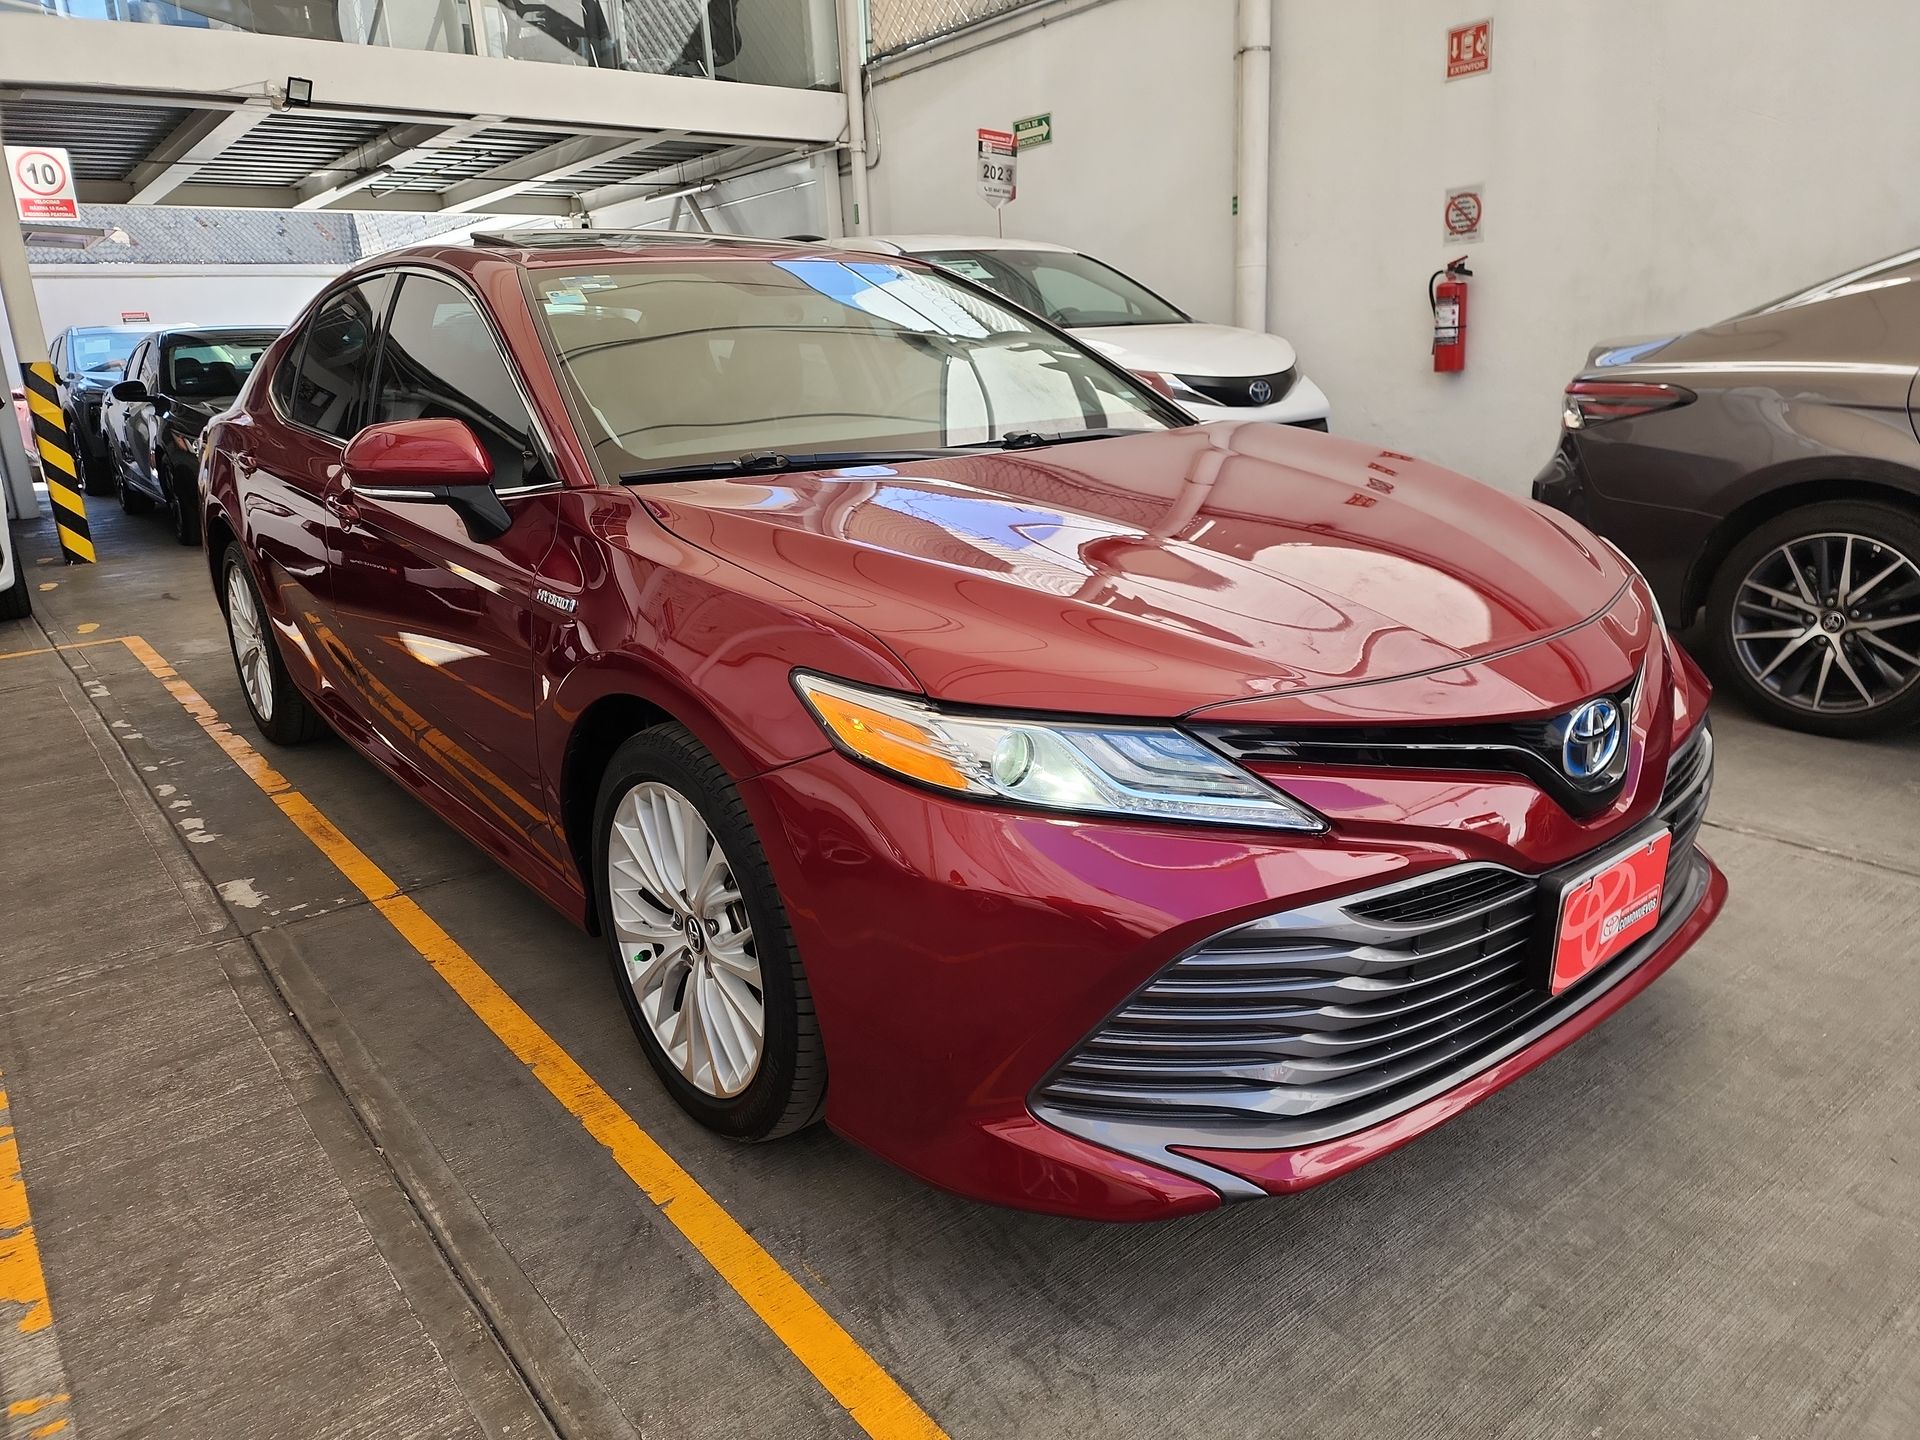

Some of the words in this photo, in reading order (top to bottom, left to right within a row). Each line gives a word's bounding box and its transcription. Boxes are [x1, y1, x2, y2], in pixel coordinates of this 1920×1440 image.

[1450, 60, 1486, 75] EXTINTOR
[1019, 122, 1031, 130] RUTA
[26, 163, 56, 185] 10
[983, 164, 1013, 182] 2023
[536, 588, 570, 611] HYBRID
[1617, 897, 1657, 932] COMONUEVOS
